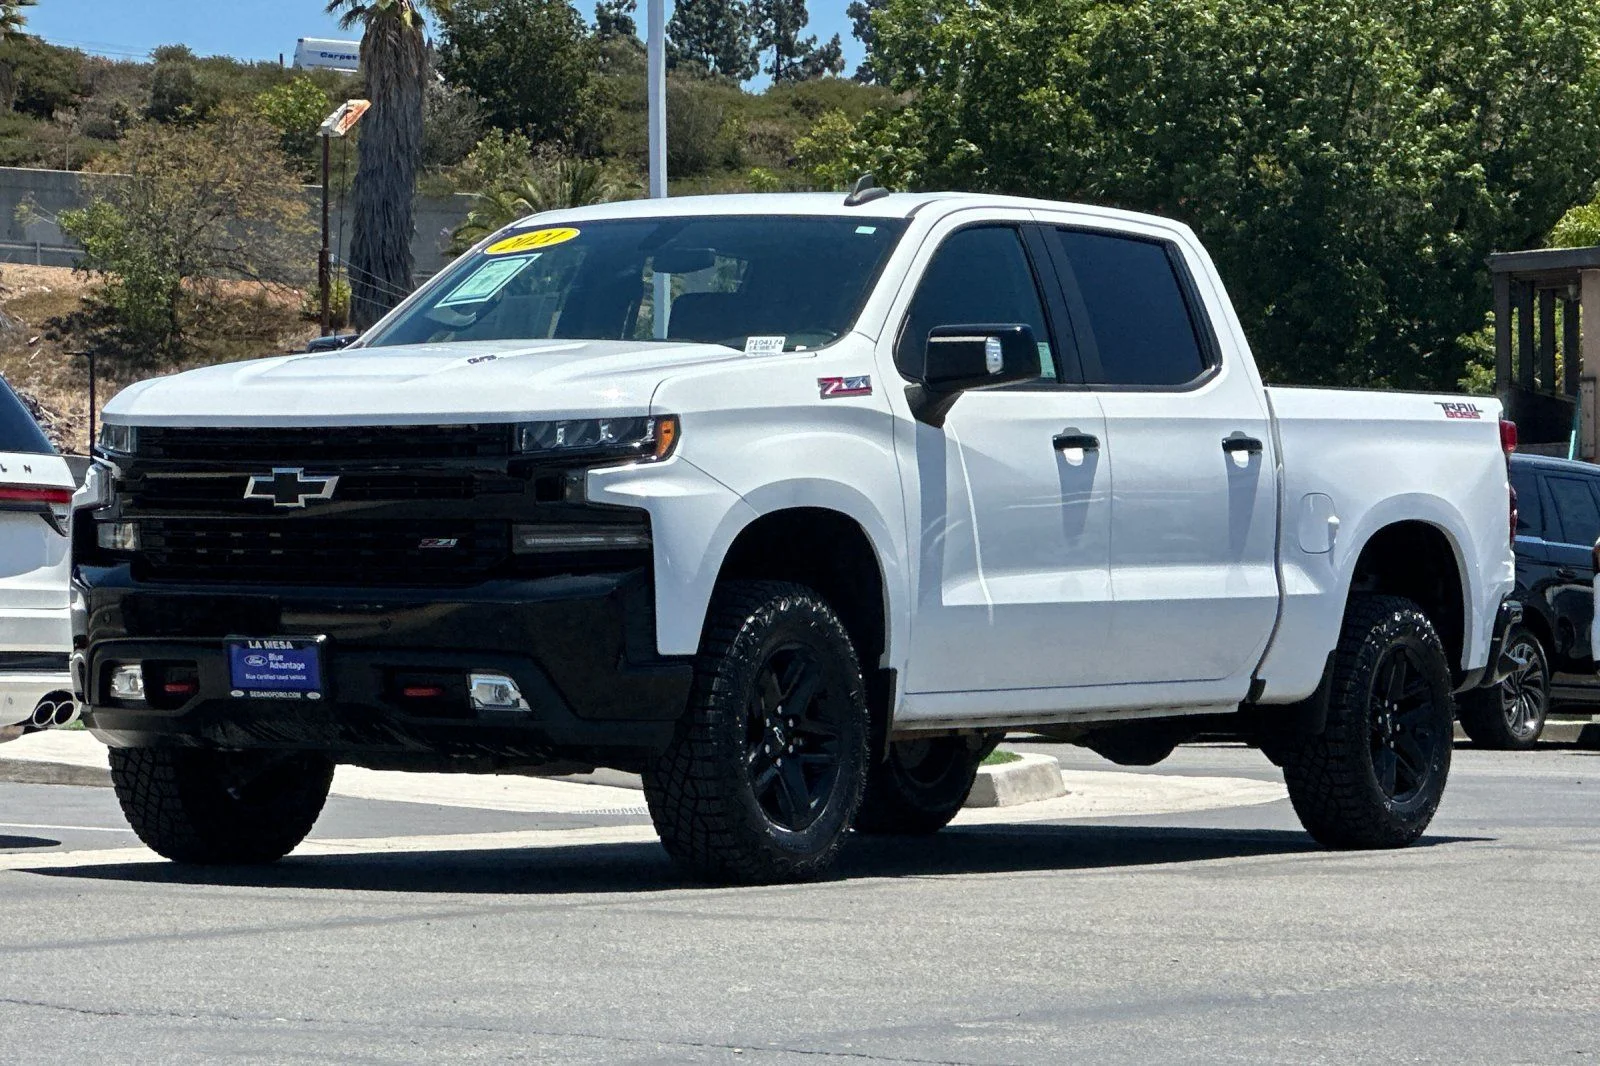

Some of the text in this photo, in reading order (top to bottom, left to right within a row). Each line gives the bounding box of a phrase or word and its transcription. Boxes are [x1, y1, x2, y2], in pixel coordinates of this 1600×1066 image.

[496, 230, 569, 251] 2021
[817, 374, 873, 400] Z71
[1434, 401, 1484, 412] TRAIL
[1445, 411, 1481, 419] BOSS
[248, 640, 293, 650] LA MESA
[268, 653, 283, 661] Blue
[269, 662, 305, 671] Advantage
